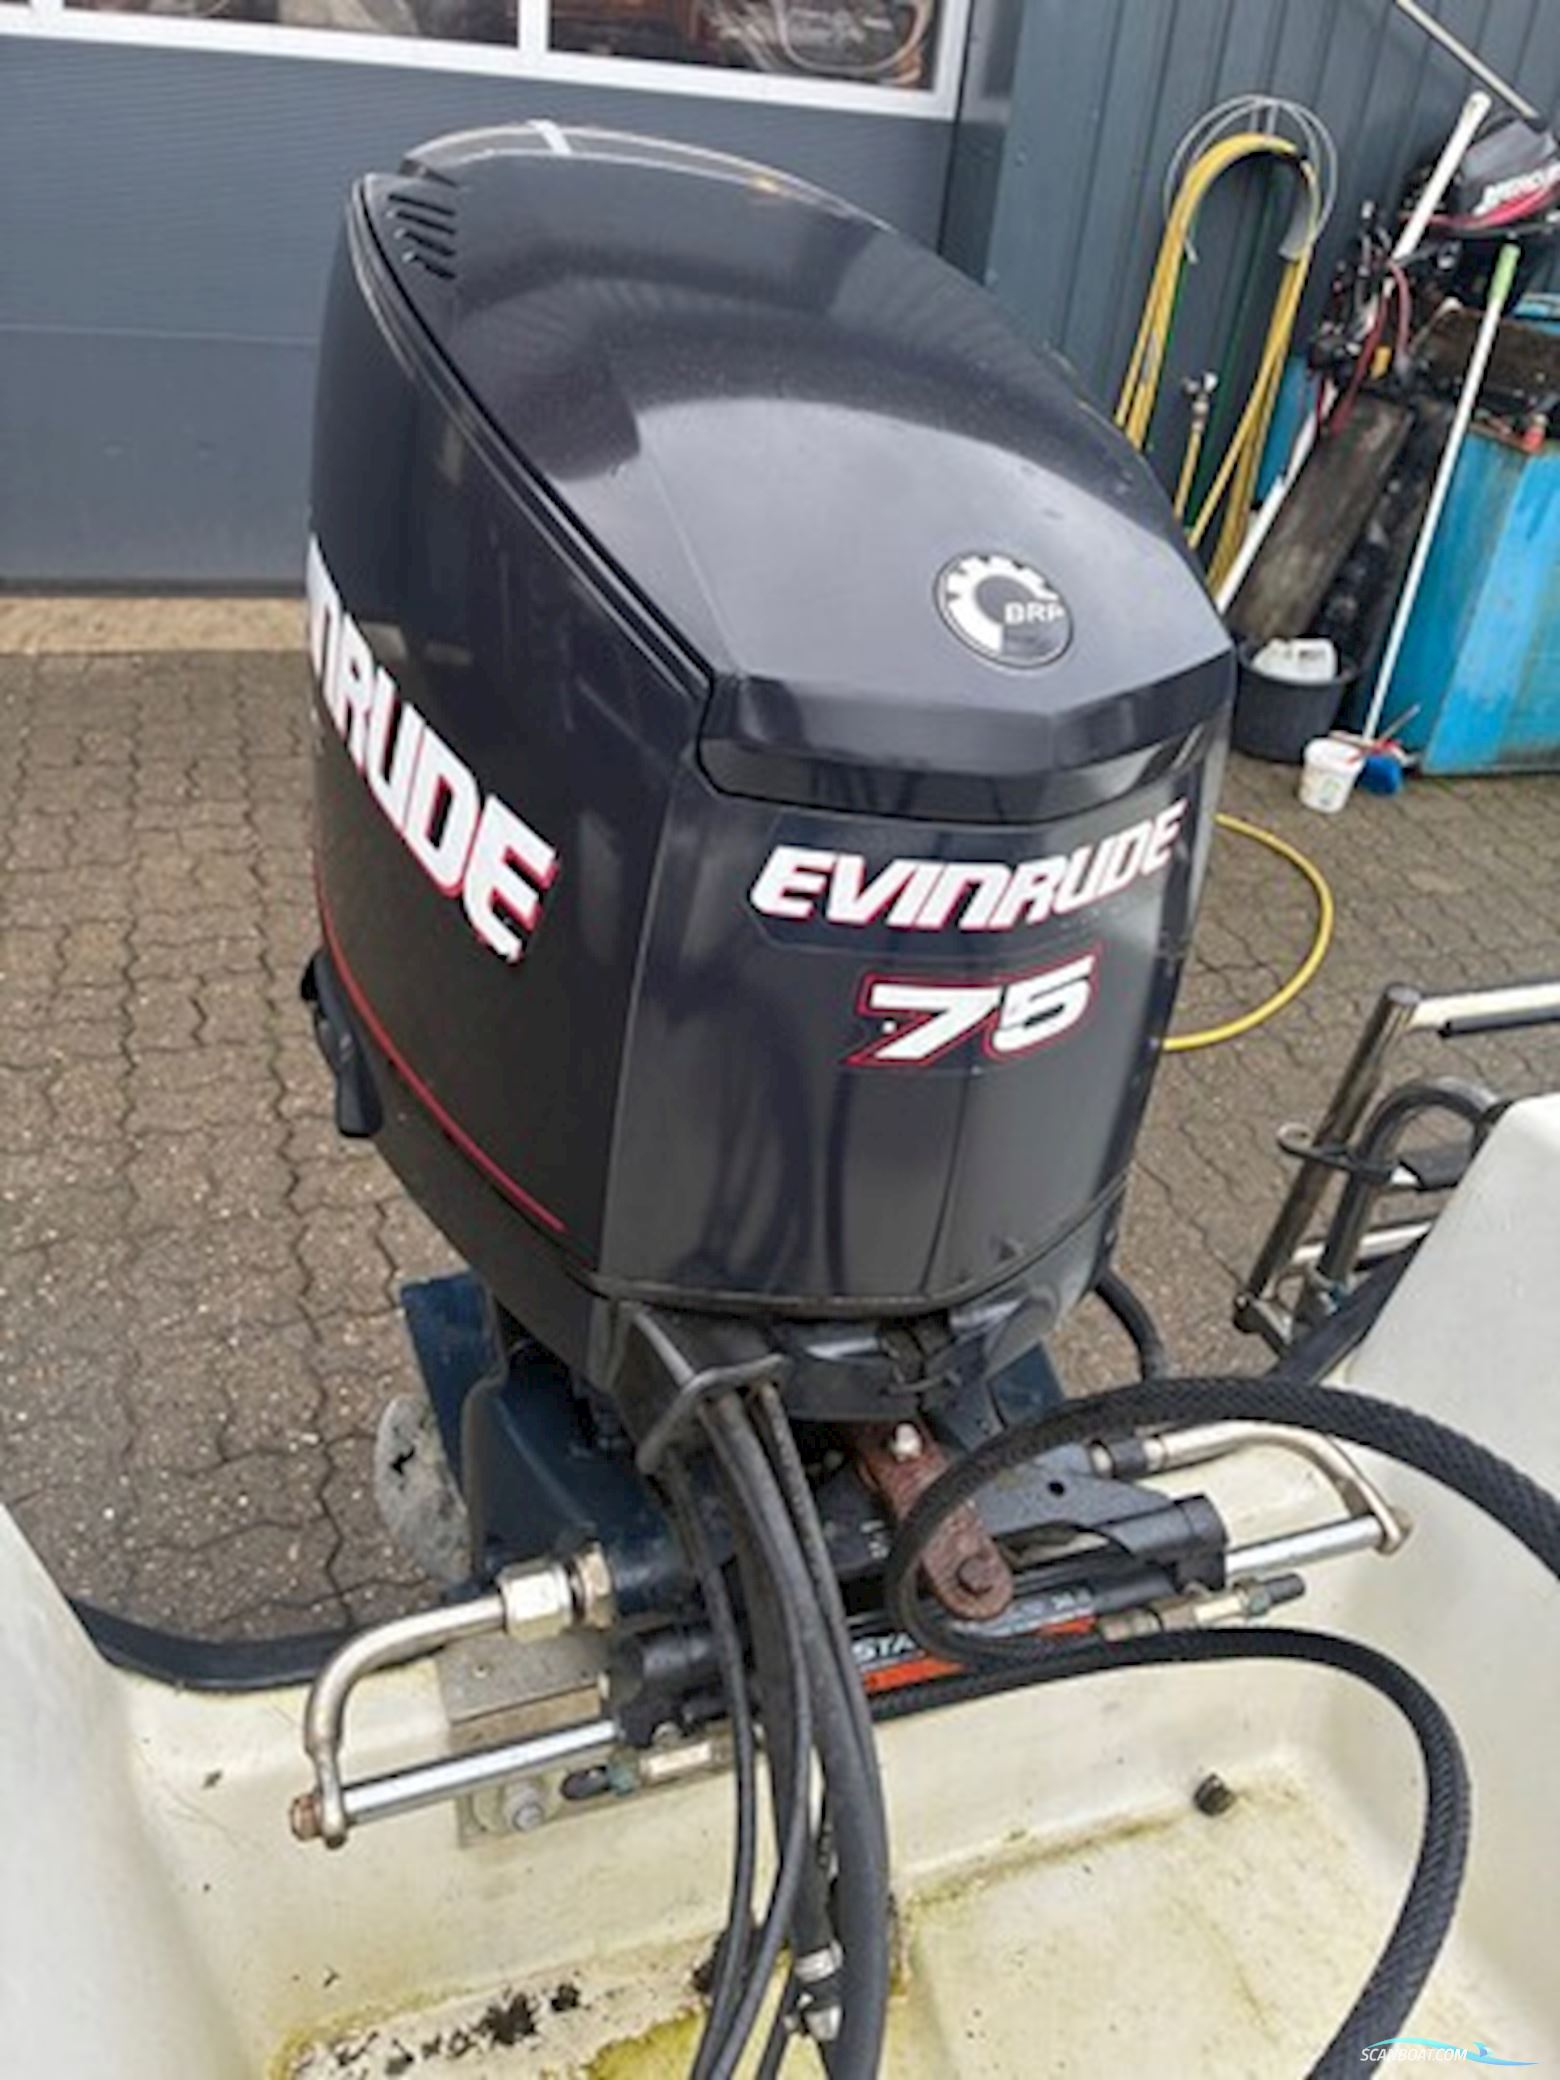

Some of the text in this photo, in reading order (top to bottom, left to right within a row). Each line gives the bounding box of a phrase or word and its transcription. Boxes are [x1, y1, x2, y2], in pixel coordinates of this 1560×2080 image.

[306, 533, 560, 964] NRUDE
[750, 798, 1188, 931] EVINRUDE
[858, 950, 1100, 1064] 75
